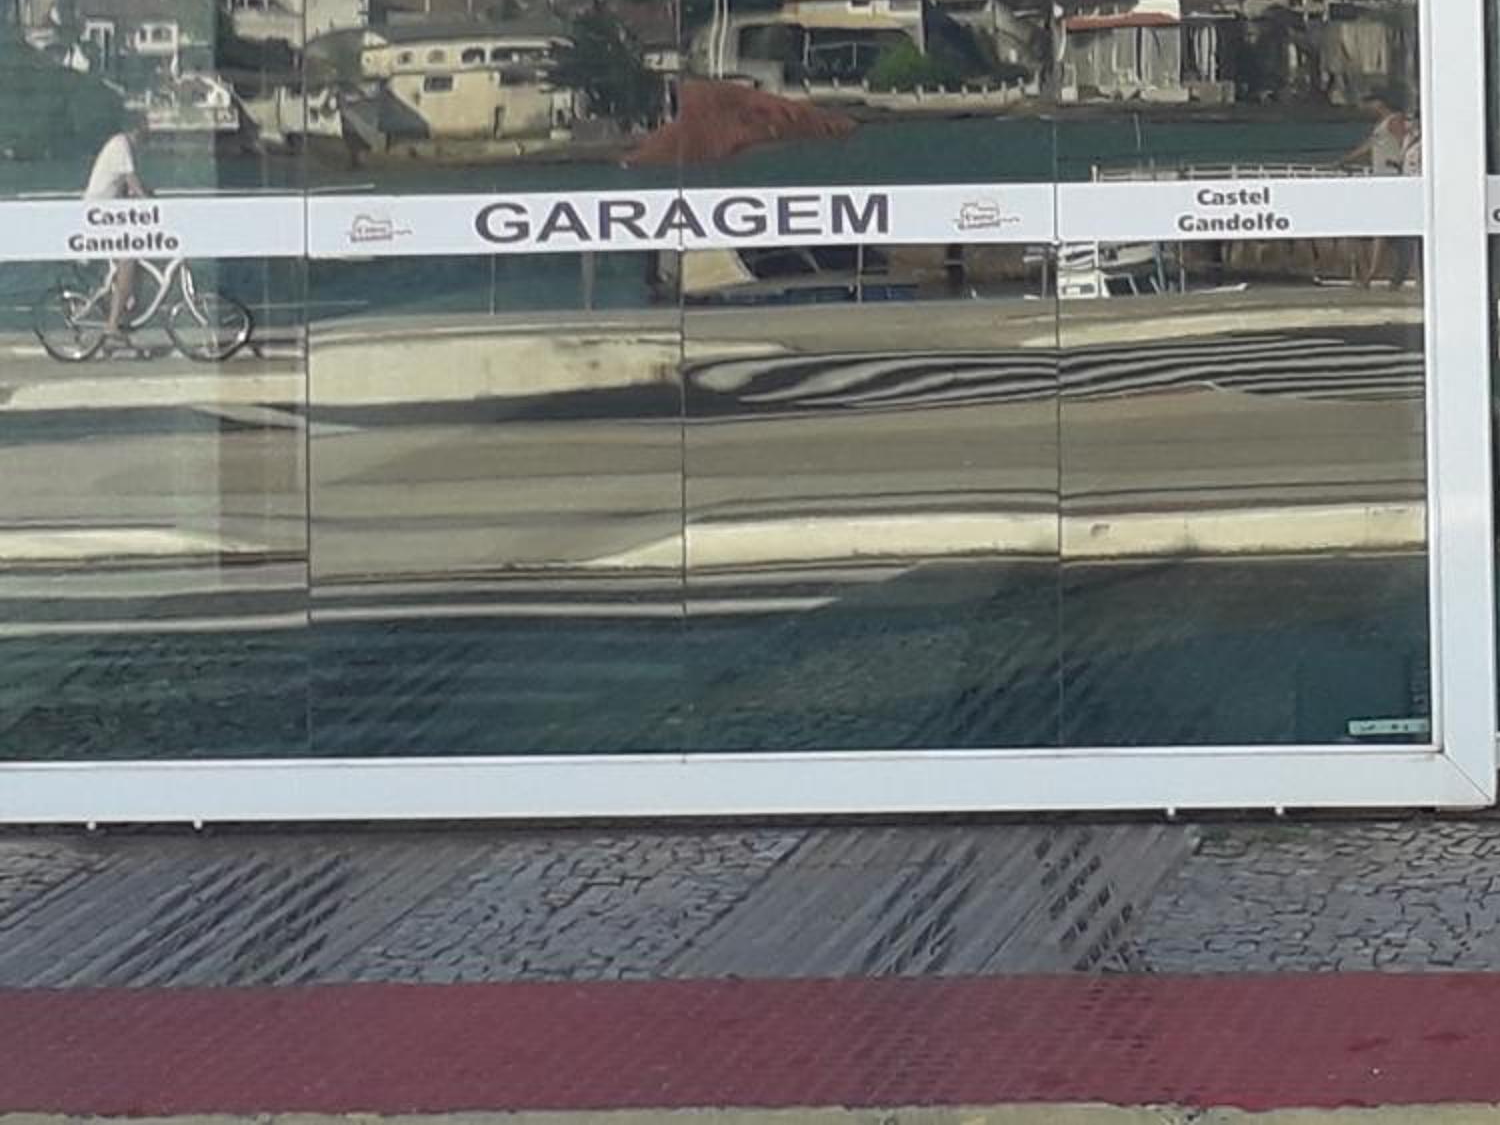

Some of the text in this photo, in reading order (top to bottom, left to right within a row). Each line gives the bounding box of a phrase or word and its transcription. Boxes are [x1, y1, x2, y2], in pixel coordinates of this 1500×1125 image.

[1197, 185, 1270, 206] Castel
[87, 205, 160, 226] Castel
[474, 192, 889, 244] GARAGEM
[1178, 210, 1290, 232] Gandolfo
[68, 230, 180, 252] Gandolfo
